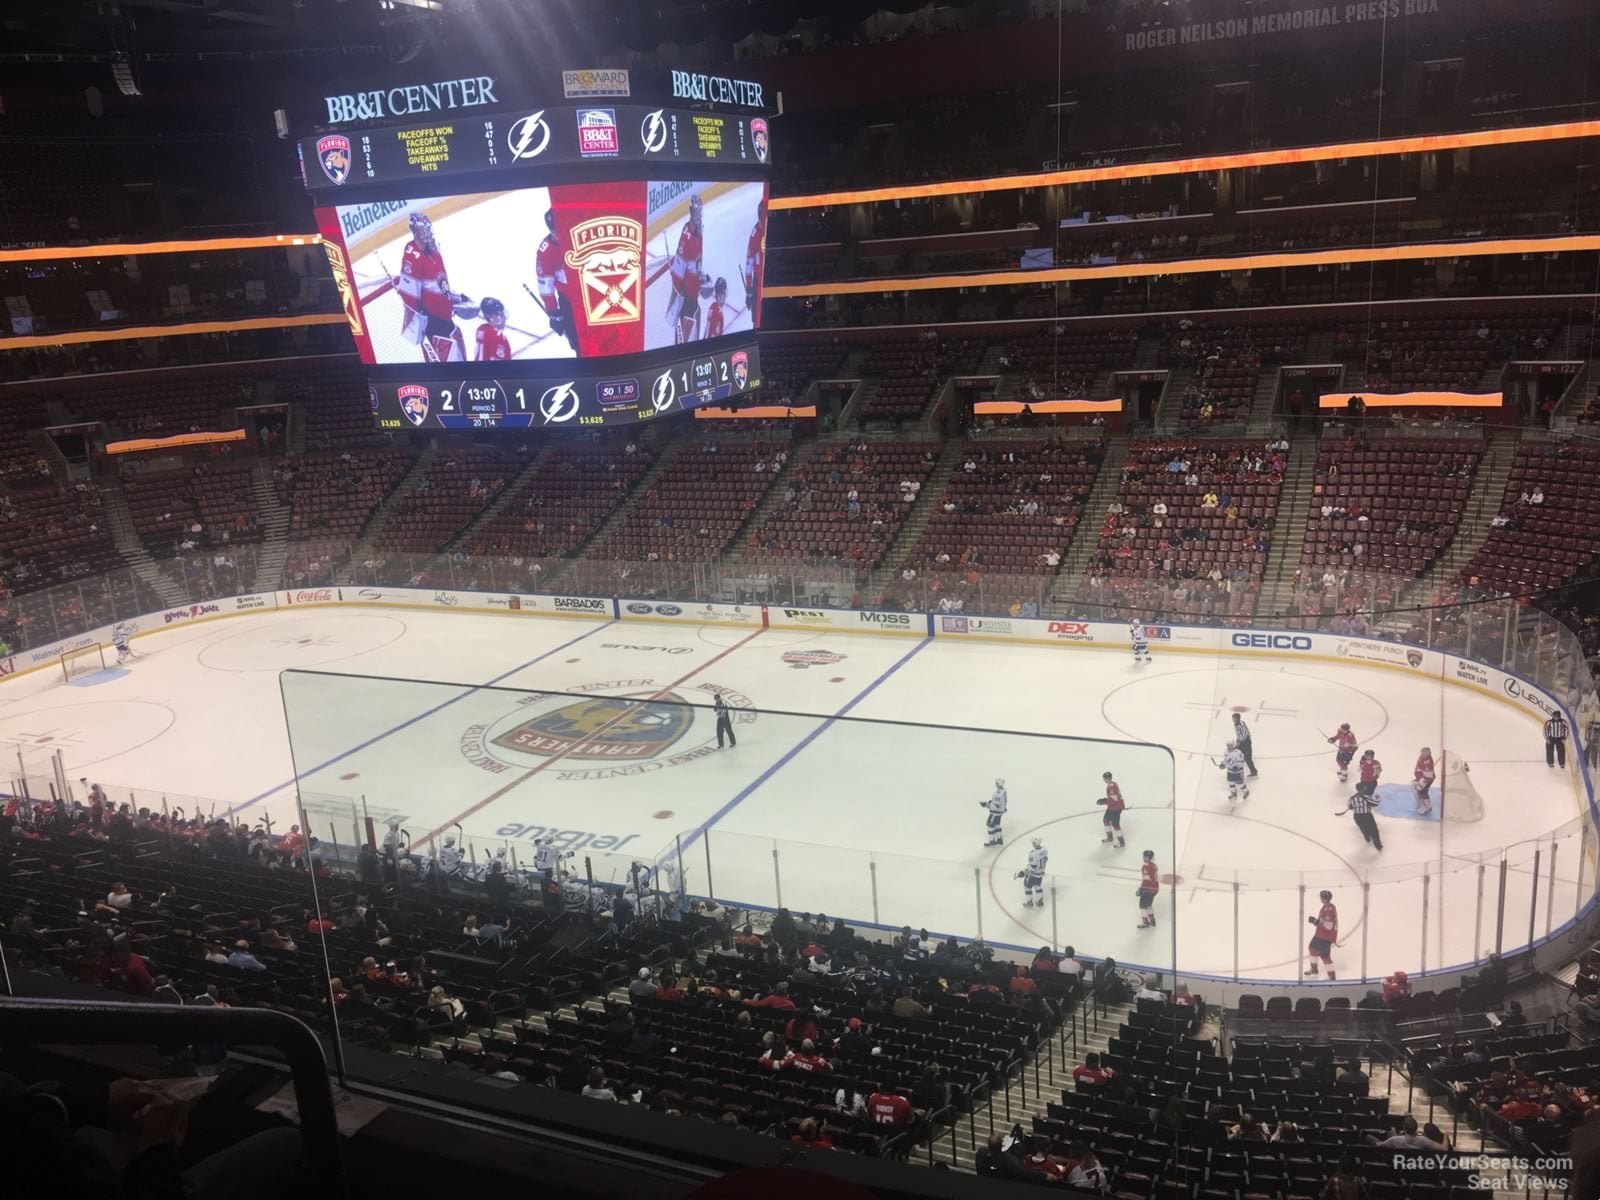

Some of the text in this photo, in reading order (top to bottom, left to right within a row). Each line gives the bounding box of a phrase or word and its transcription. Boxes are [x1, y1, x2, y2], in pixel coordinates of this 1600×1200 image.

[1126, 28, 1176, 50] ROGER
[1180, 18, 1248, 44] NEILSON
[1252, 6, 1340, 34] MEMORIAL
[1345, 0, 1400, 23] PRESS
[565, 72, 627, 85] BROWARD
[671, 69, 765, 108] BB&T CENTER
[325, 76, 498, 124] BB&T CENTER
[398, 126, 454, 140] FACEOFFS WON
[485, 131, 493, 139] 47
[582, 128, 614, 141] BB&T
[406, 137, 438, 147] FACEOFF
[583, 141, 616, 150] CENTER
[365, 153, 370, 161] 2
[406, 145, 449, 156] TAKEAWAYS
[408, 153, 449, 165] GIVEAWAYS
[489, 157, 497, 165] 11
[421, 163, 438, 172] HITS
[649, 181, 693, 215] Heineken
[341, 200, 409, 237] Heineken
[580, 224, 636, 242] FLORIDA
[695, 362, 712, 376] 13:07
[720, 361, 728, 381] 2
[1560, 365, 1576, 374] 122
[682, 371, 688, 392] 1
[467, 387, 497, 400] 13:07
[603, 385, 634, 396] 50 50
[440, 390, 454, 410] 2
[515, 388, 526, 409] 1
[580, 416, 604, 424] $3,625
[297, 590, 332, 603] Coca-Cola
[554, 597, 605, 609] BARBADOS
[631, 605, 649, 614] Ford
[660, 606, 677, 615] Ford
[784, 609, 825, 618] PEST
[860, 611, 910, 623] MOSS
[1048, 622, 1089, 635] DEX
[1056, 633, 1094, 642] imaging
[1232, 633, 1312, 650] GEICO
[1349, 641, 1382, 652] PANTHERS
[32, 646, 65, 662] Walmart
[1456, 670, 1488, 685] WATCH LIVE
[515, 733, 647, 755] PANTHERS
